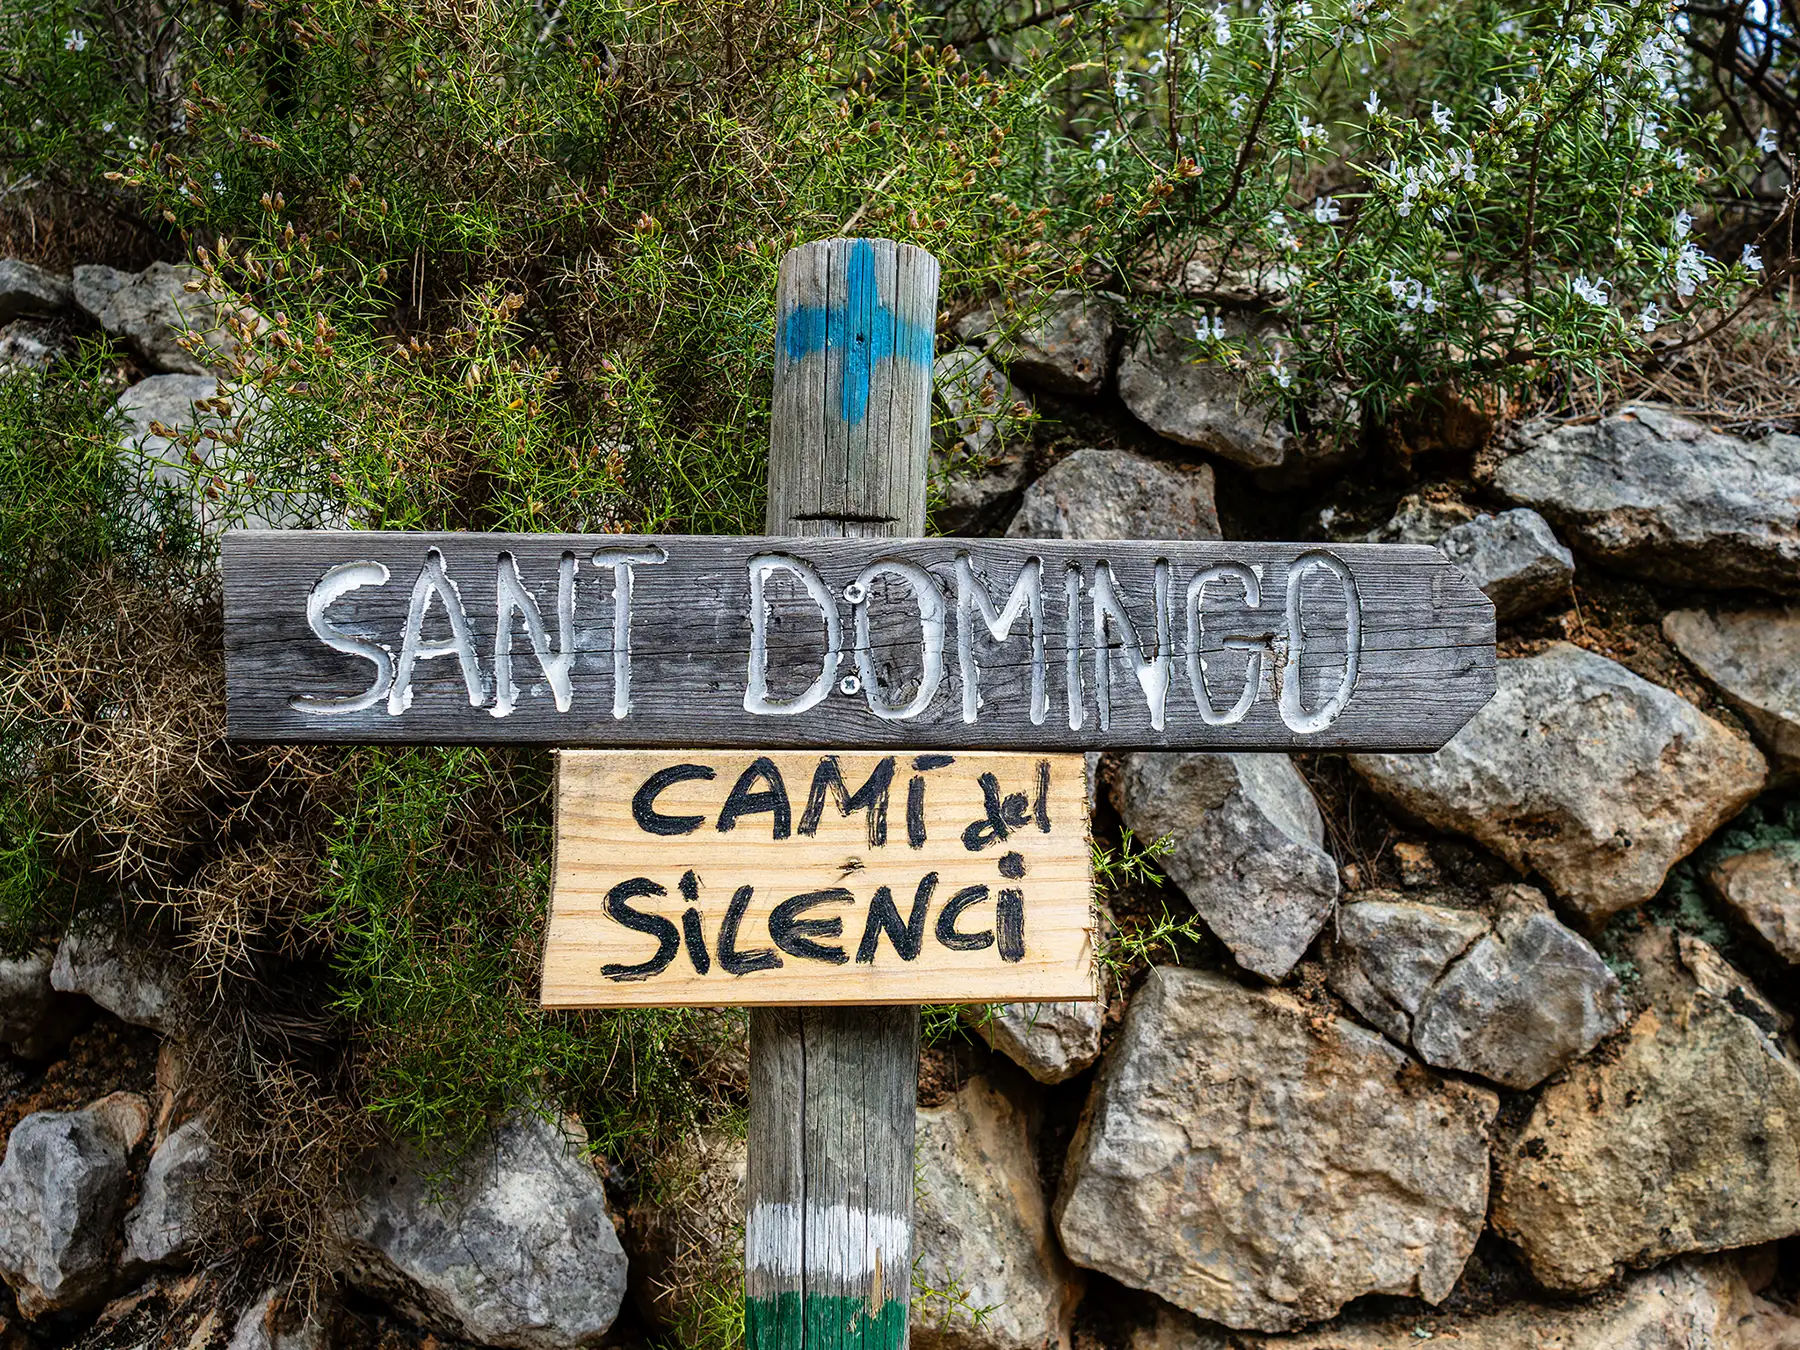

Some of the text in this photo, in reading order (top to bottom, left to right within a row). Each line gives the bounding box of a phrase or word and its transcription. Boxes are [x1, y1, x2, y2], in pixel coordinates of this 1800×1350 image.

[289, 545, 1361, 734] SANT DOMINGO
[960, 759, 1052, 852] del
